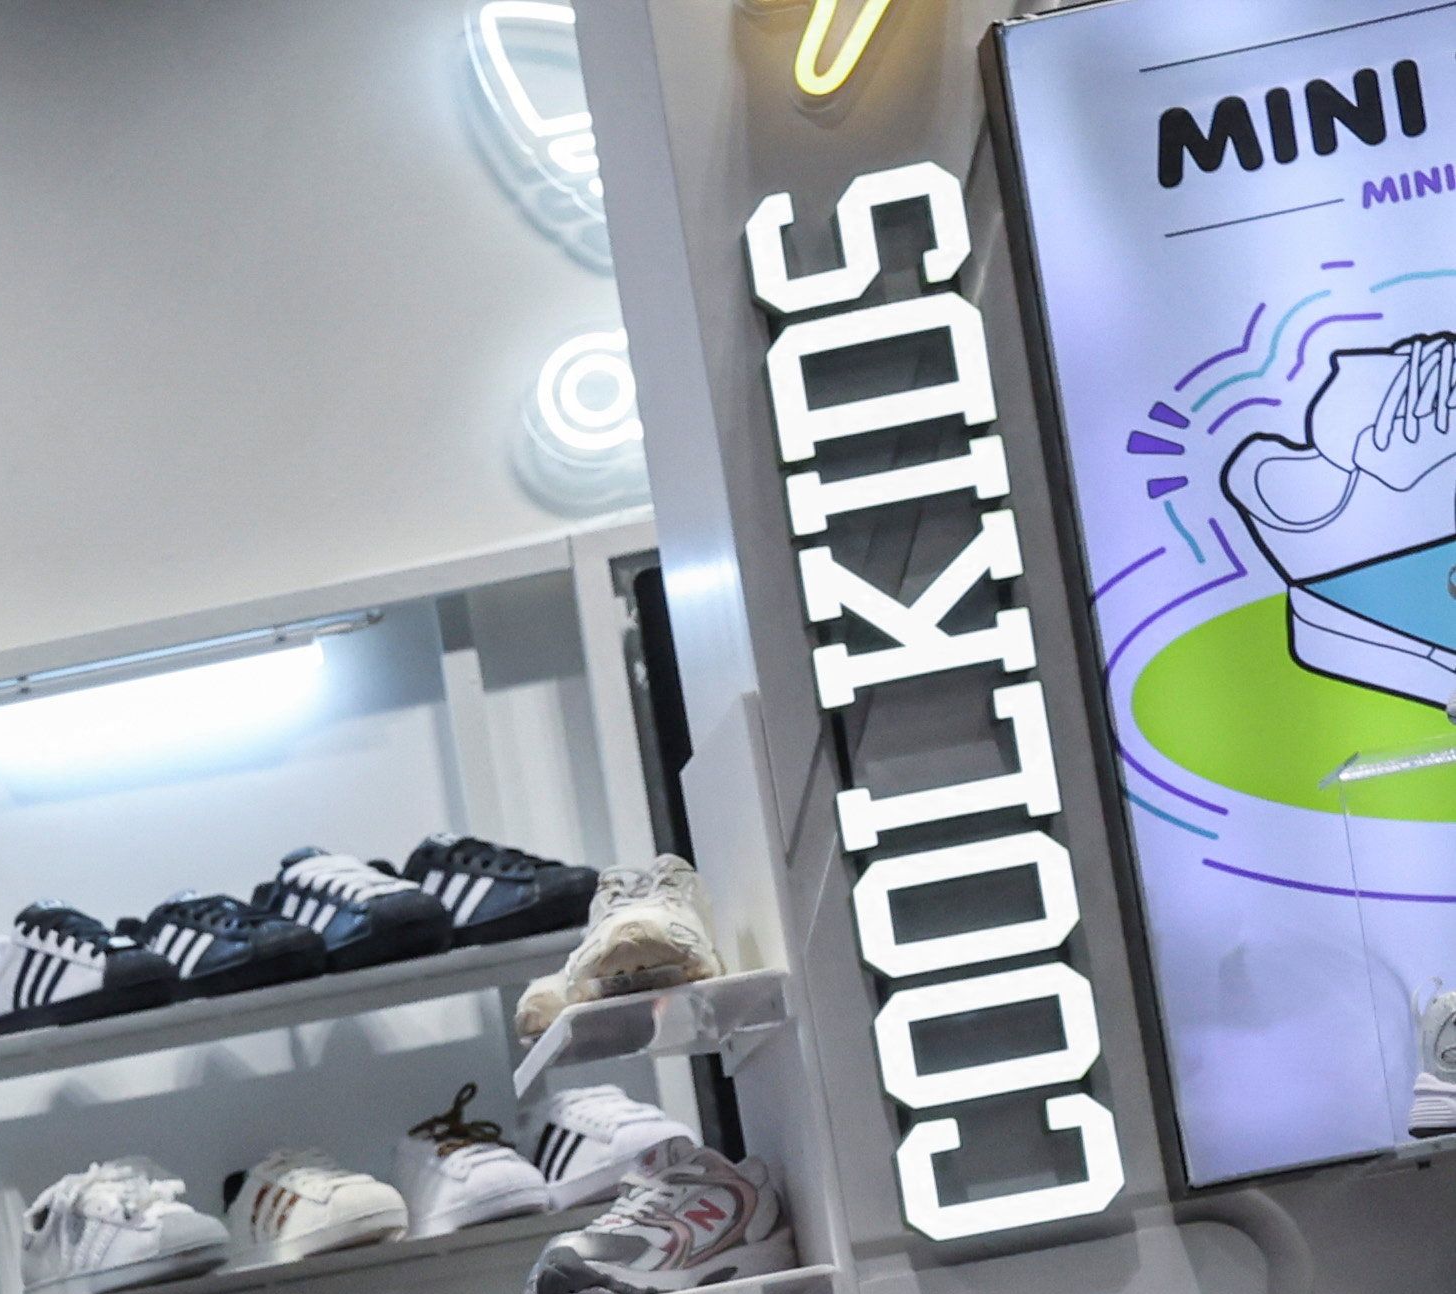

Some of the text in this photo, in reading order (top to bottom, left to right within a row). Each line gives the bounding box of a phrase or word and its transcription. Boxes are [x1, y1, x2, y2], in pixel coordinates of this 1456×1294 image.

[1158, 59, 1427, 189] MINI
[1362, 163, 1456, 209] MINI
[746, 162, 1125, 1240] COOLKIDS
